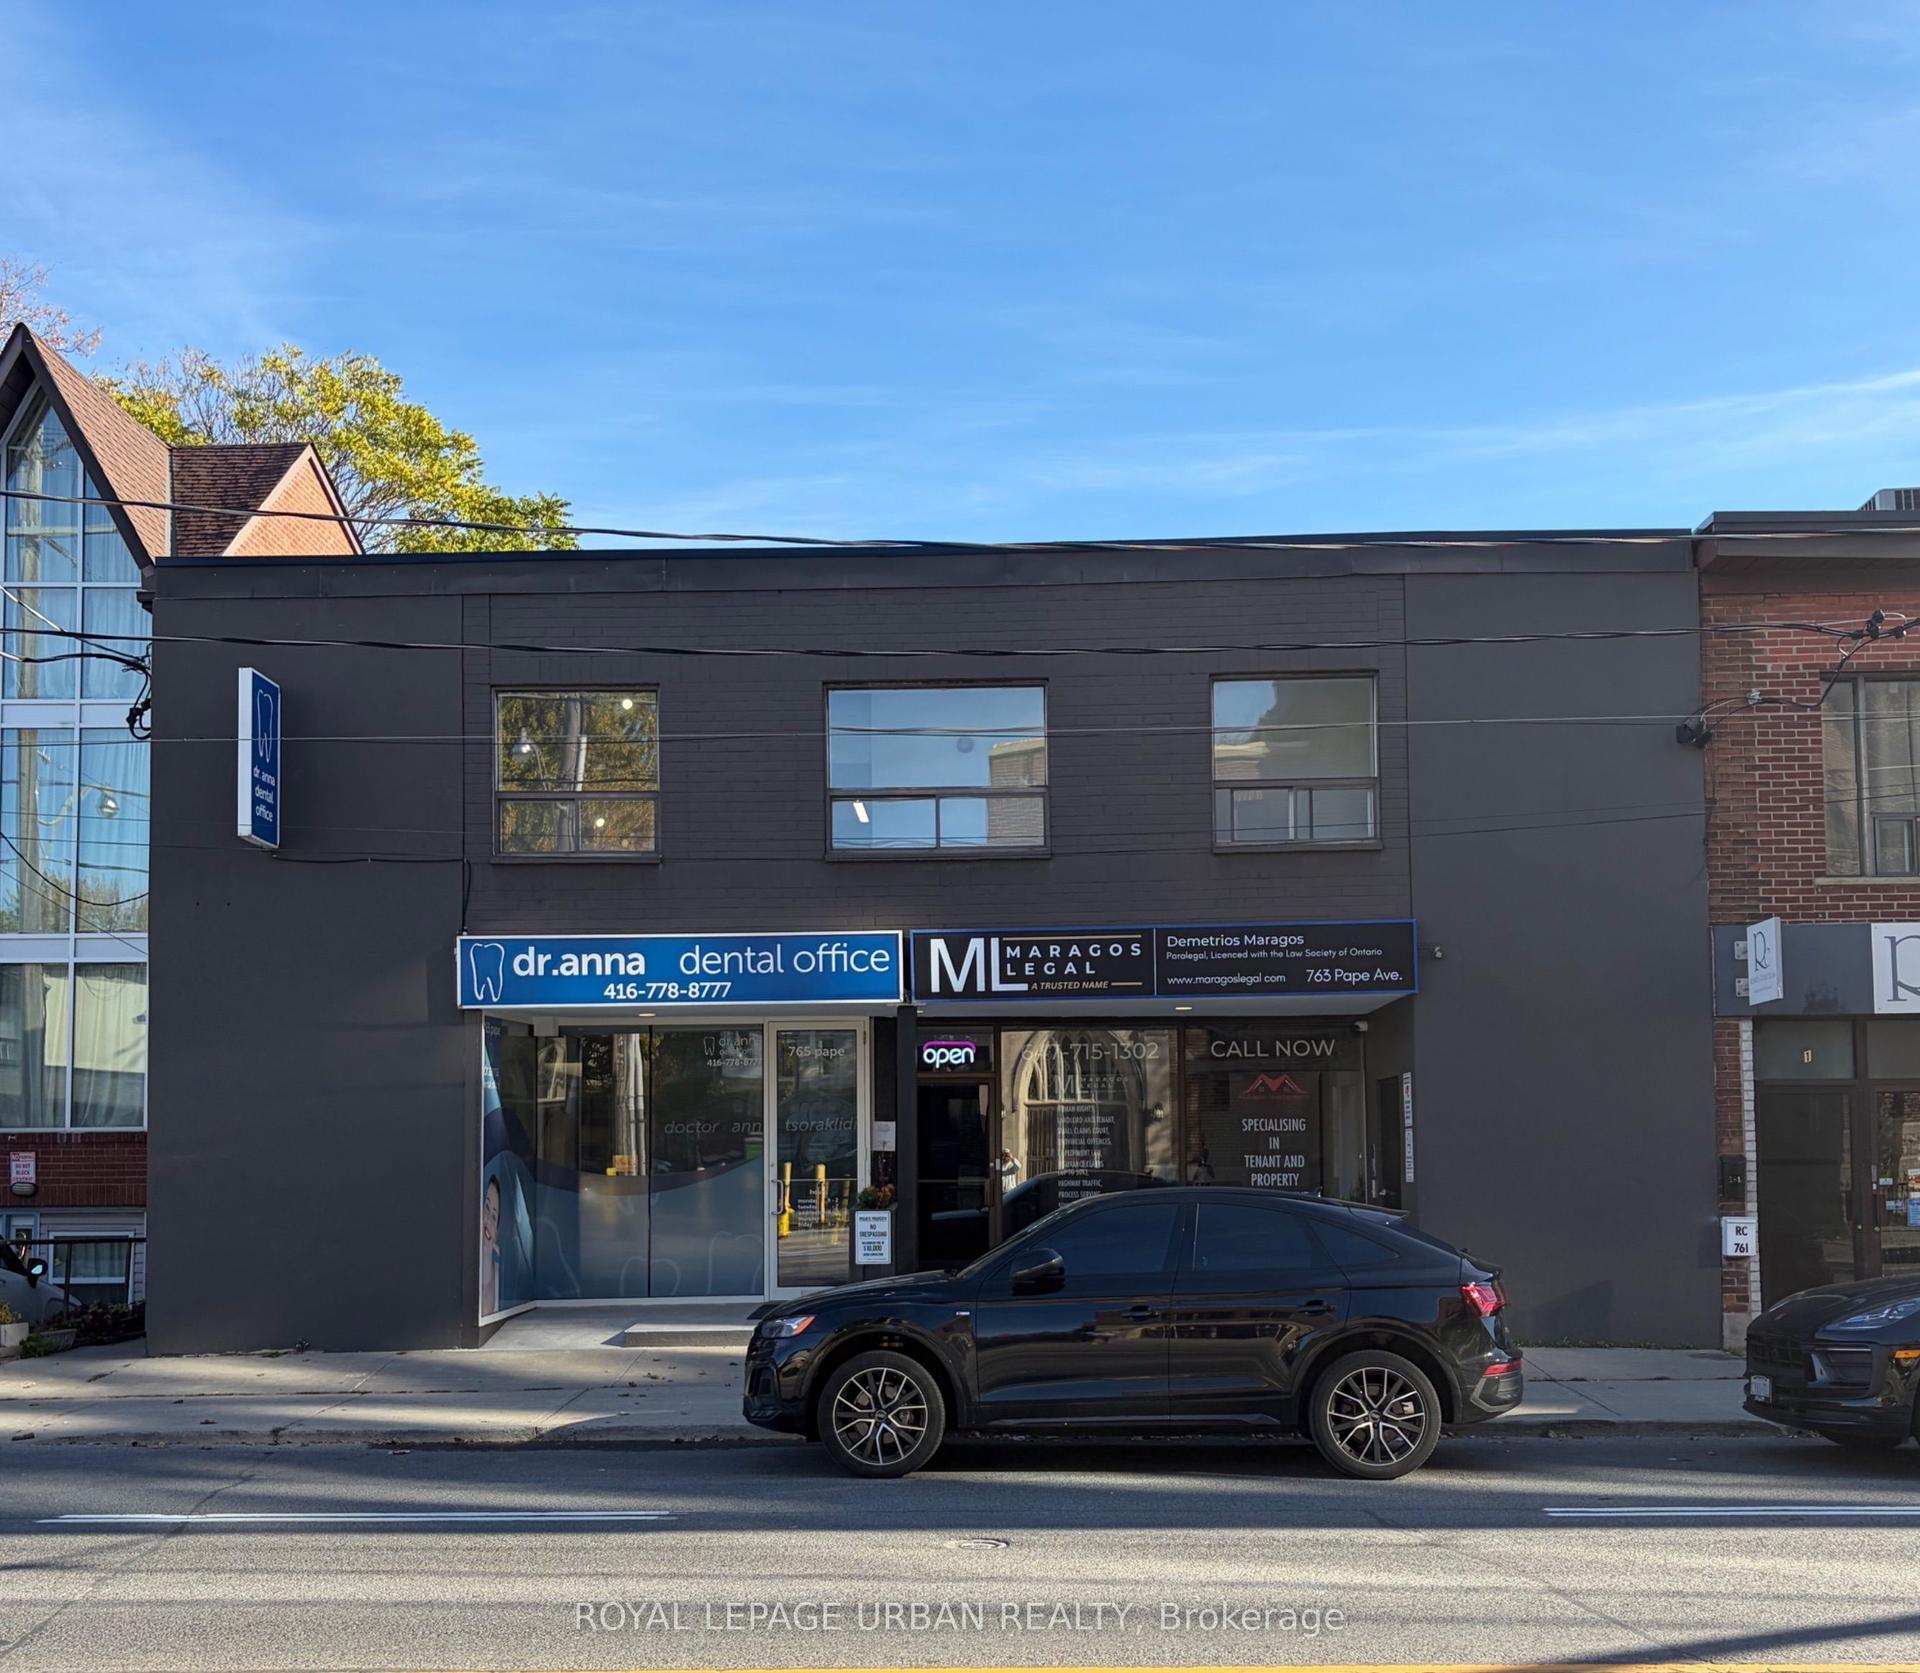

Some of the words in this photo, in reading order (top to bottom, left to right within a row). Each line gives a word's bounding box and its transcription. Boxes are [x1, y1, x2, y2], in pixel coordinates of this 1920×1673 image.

[255, 784, 274, 804] dental
[256, 804, 273, 822] office
[1167, 934, 1240, 948] Demetrios
[1244, 934, 1305, 948] Maragos
[1006, 943, 1142, 958] MARAGOS
[1166, 951, 1209, 962] Paralegal,
[1250, 949, 1268, 959] with
[1270, 949, 1284, 958] the
[1285, 949, 1303, 958] Law
[1305, 948, 1337, 959] Society
[1338, 947, 1348, 957] of
[1349, 947, 1383, 957] Ontario
[513, 946, 645, 976] dr.anna
[680, 945, 784, 975] dental
[793, 943, 889, 973] office
[930, 937, 1028, 993] ML
[1006, 961, 1096, 976] LEGAL
[1306, 969, 1332, 983] 763
[1334, 968, 1370, 986] Pape
[1373, 967, 1403, 981] Ave.
[604, 982, 732, 999] 416-778-8777
[1031, 982, 1038, 991] A
[1040, 981, 1080, 990] TRUSTED
[1082, 980, 1109, 989] NAME
[788, 1046, 811, 1057] 765
[814, 1047, 845, 1060] pape
[1211, 1041, 1269, 1058] CALL
[1275, 1040, 1335, 1057] NOW
[923, 1047, 975, 1069] open
[664, 1120, 719, 1134] doctor
[1242, 1118, 1306, 1131] SPECIALISING
[1269, 1137, 1280, 1150] IN
[1244, 1155, 1281, 1168] TENANT
[1284, 1155, 1305, 1168] AND
[1251, 1173, 1299, 1186] PROPERTY
[1736, 1226, 1748, 1236] RC
[1734, 1243, 1749, 1253] 761
